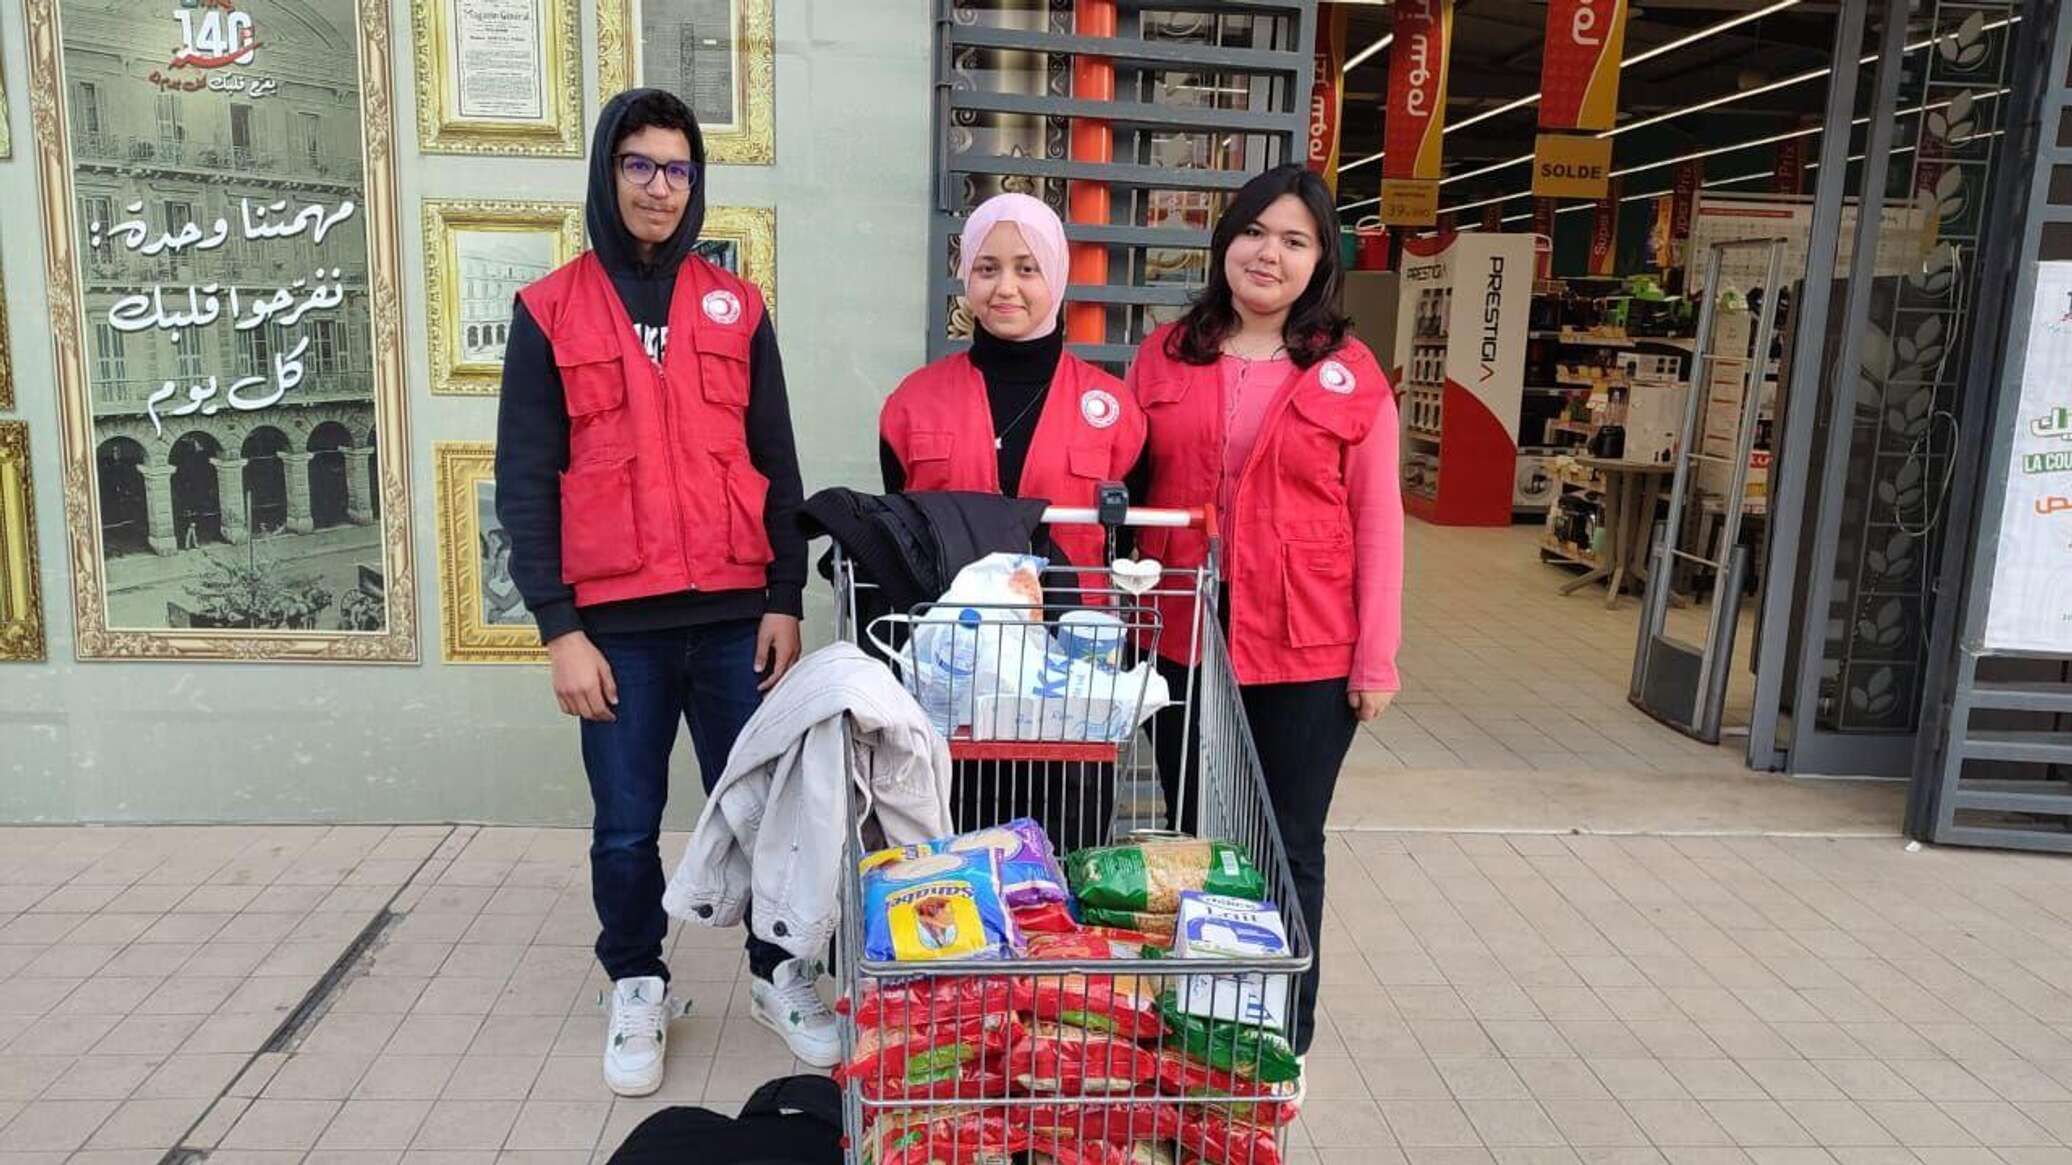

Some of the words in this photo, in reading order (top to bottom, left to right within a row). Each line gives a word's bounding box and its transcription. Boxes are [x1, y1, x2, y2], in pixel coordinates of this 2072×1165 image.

[1541, 164, 1601, 179] SOLDE
[242, 198, 355, 245] مهمتنا
[108, 284, 220, 342] قلبك
[228, 337, 310, 411] كل
[147, 374, 217, 438] يوم
